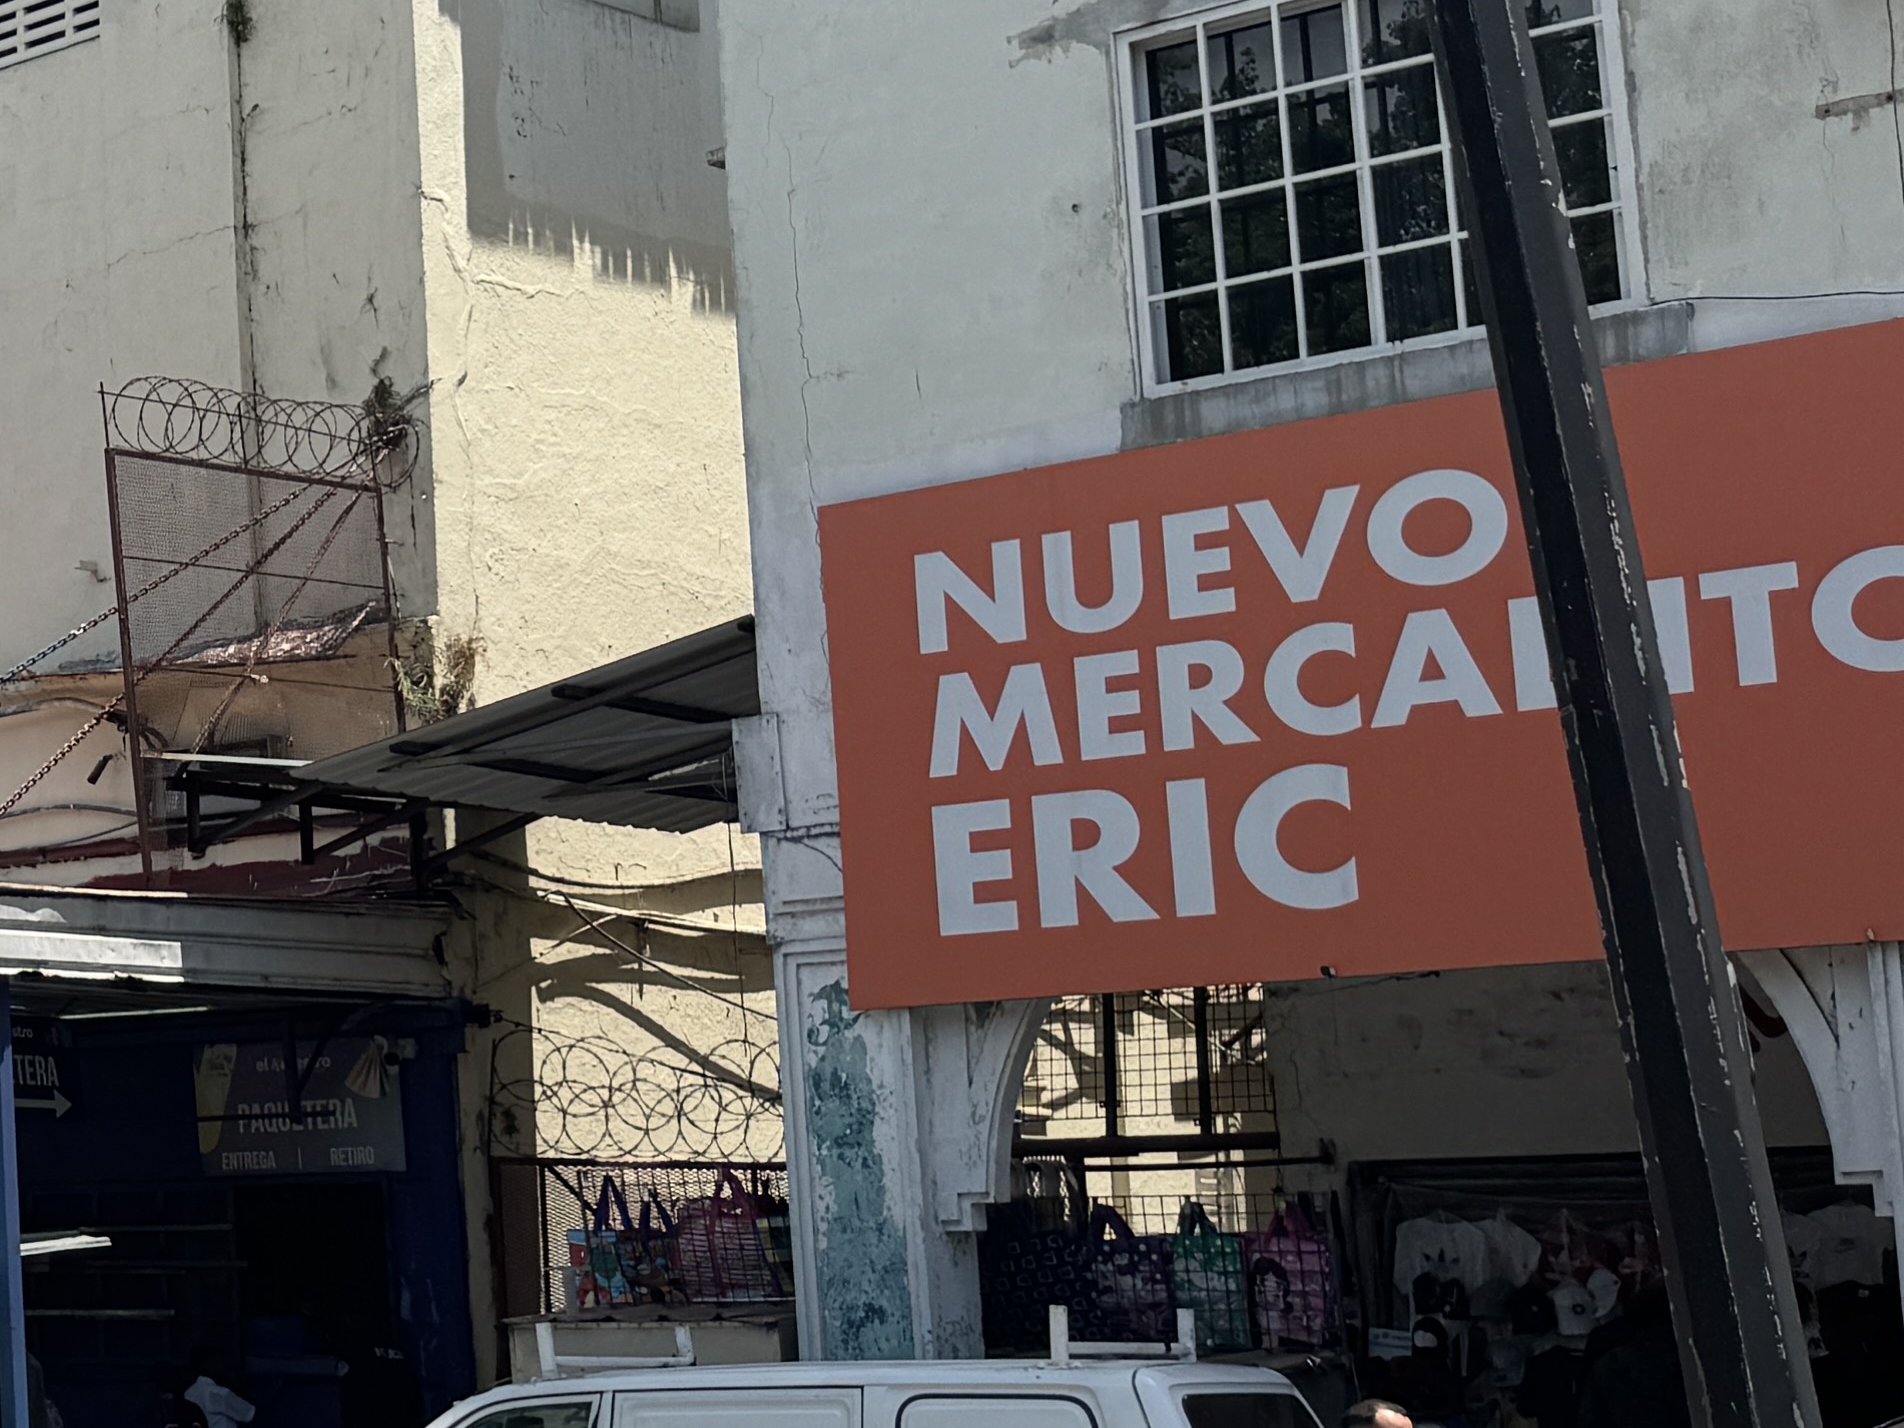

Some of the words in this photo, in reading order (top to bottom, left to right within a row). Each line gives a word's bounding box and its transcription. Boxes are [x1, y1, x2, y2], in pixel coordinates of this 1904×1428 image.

[913, 468, 1509, 655] NUEVO
[931, 763, 1360, 937] ERIC
[221, 1150, 277, 1171] ENTREGA
[329, 1145, 375, 1167] RETIRO
[237, 1097, 358, 1134] PAQUTERA
